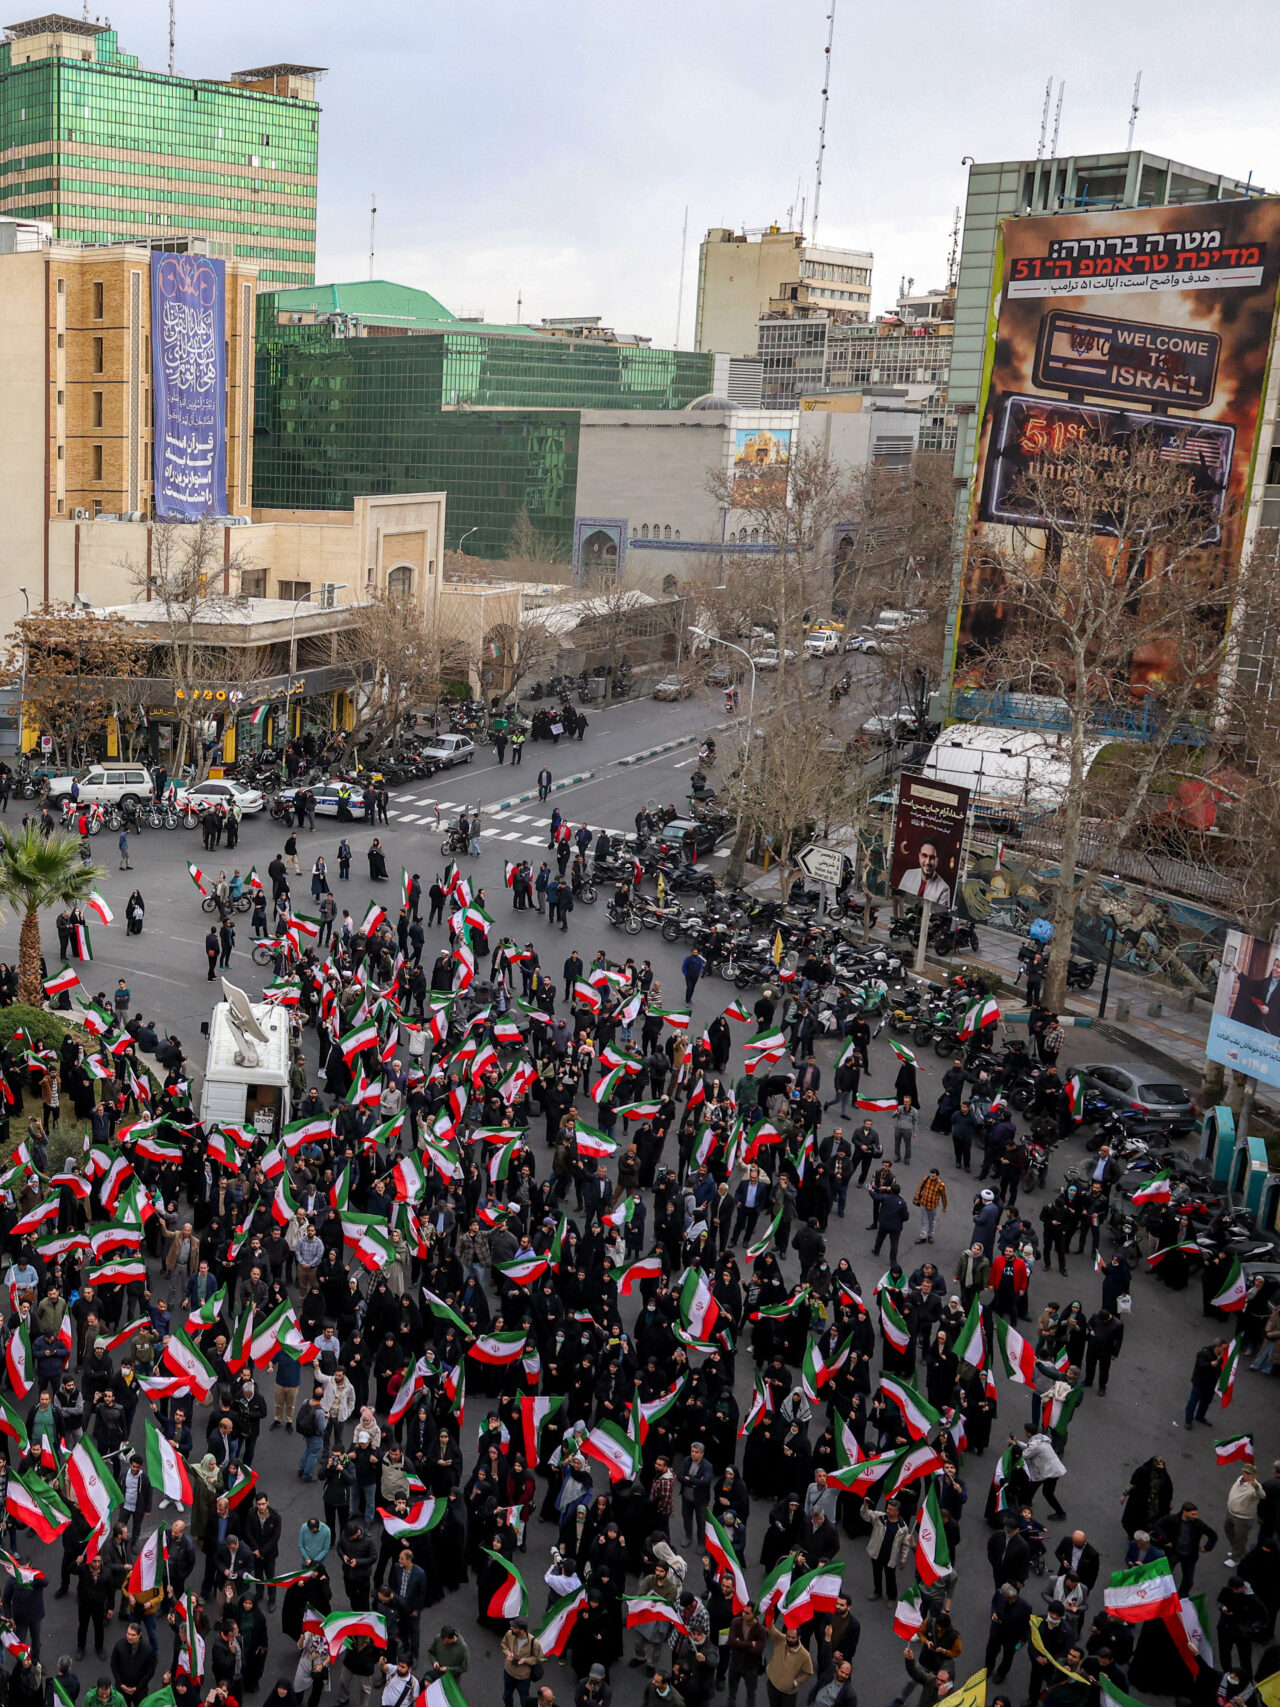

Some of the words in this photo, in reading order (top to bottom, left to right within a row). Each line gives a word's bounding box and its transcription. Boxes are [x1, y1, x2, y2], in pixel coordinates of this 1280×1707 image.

[1146, 230, 1220, 251] מטרה
[1079, 253, 1169, 275] טראמפ
[1175, 247, 1260, 269] מדינת
[1050, 280, 1079, 293] ترامپ
[1150, 275, 1180, 288] واضح
[1182, 274, 1211, 284] هدف
[1117, 330, 1209, 356] WELCOME
[1111, 364, 1203, 397] ISRAEL
[187, 432, 214, 454] قرآن
